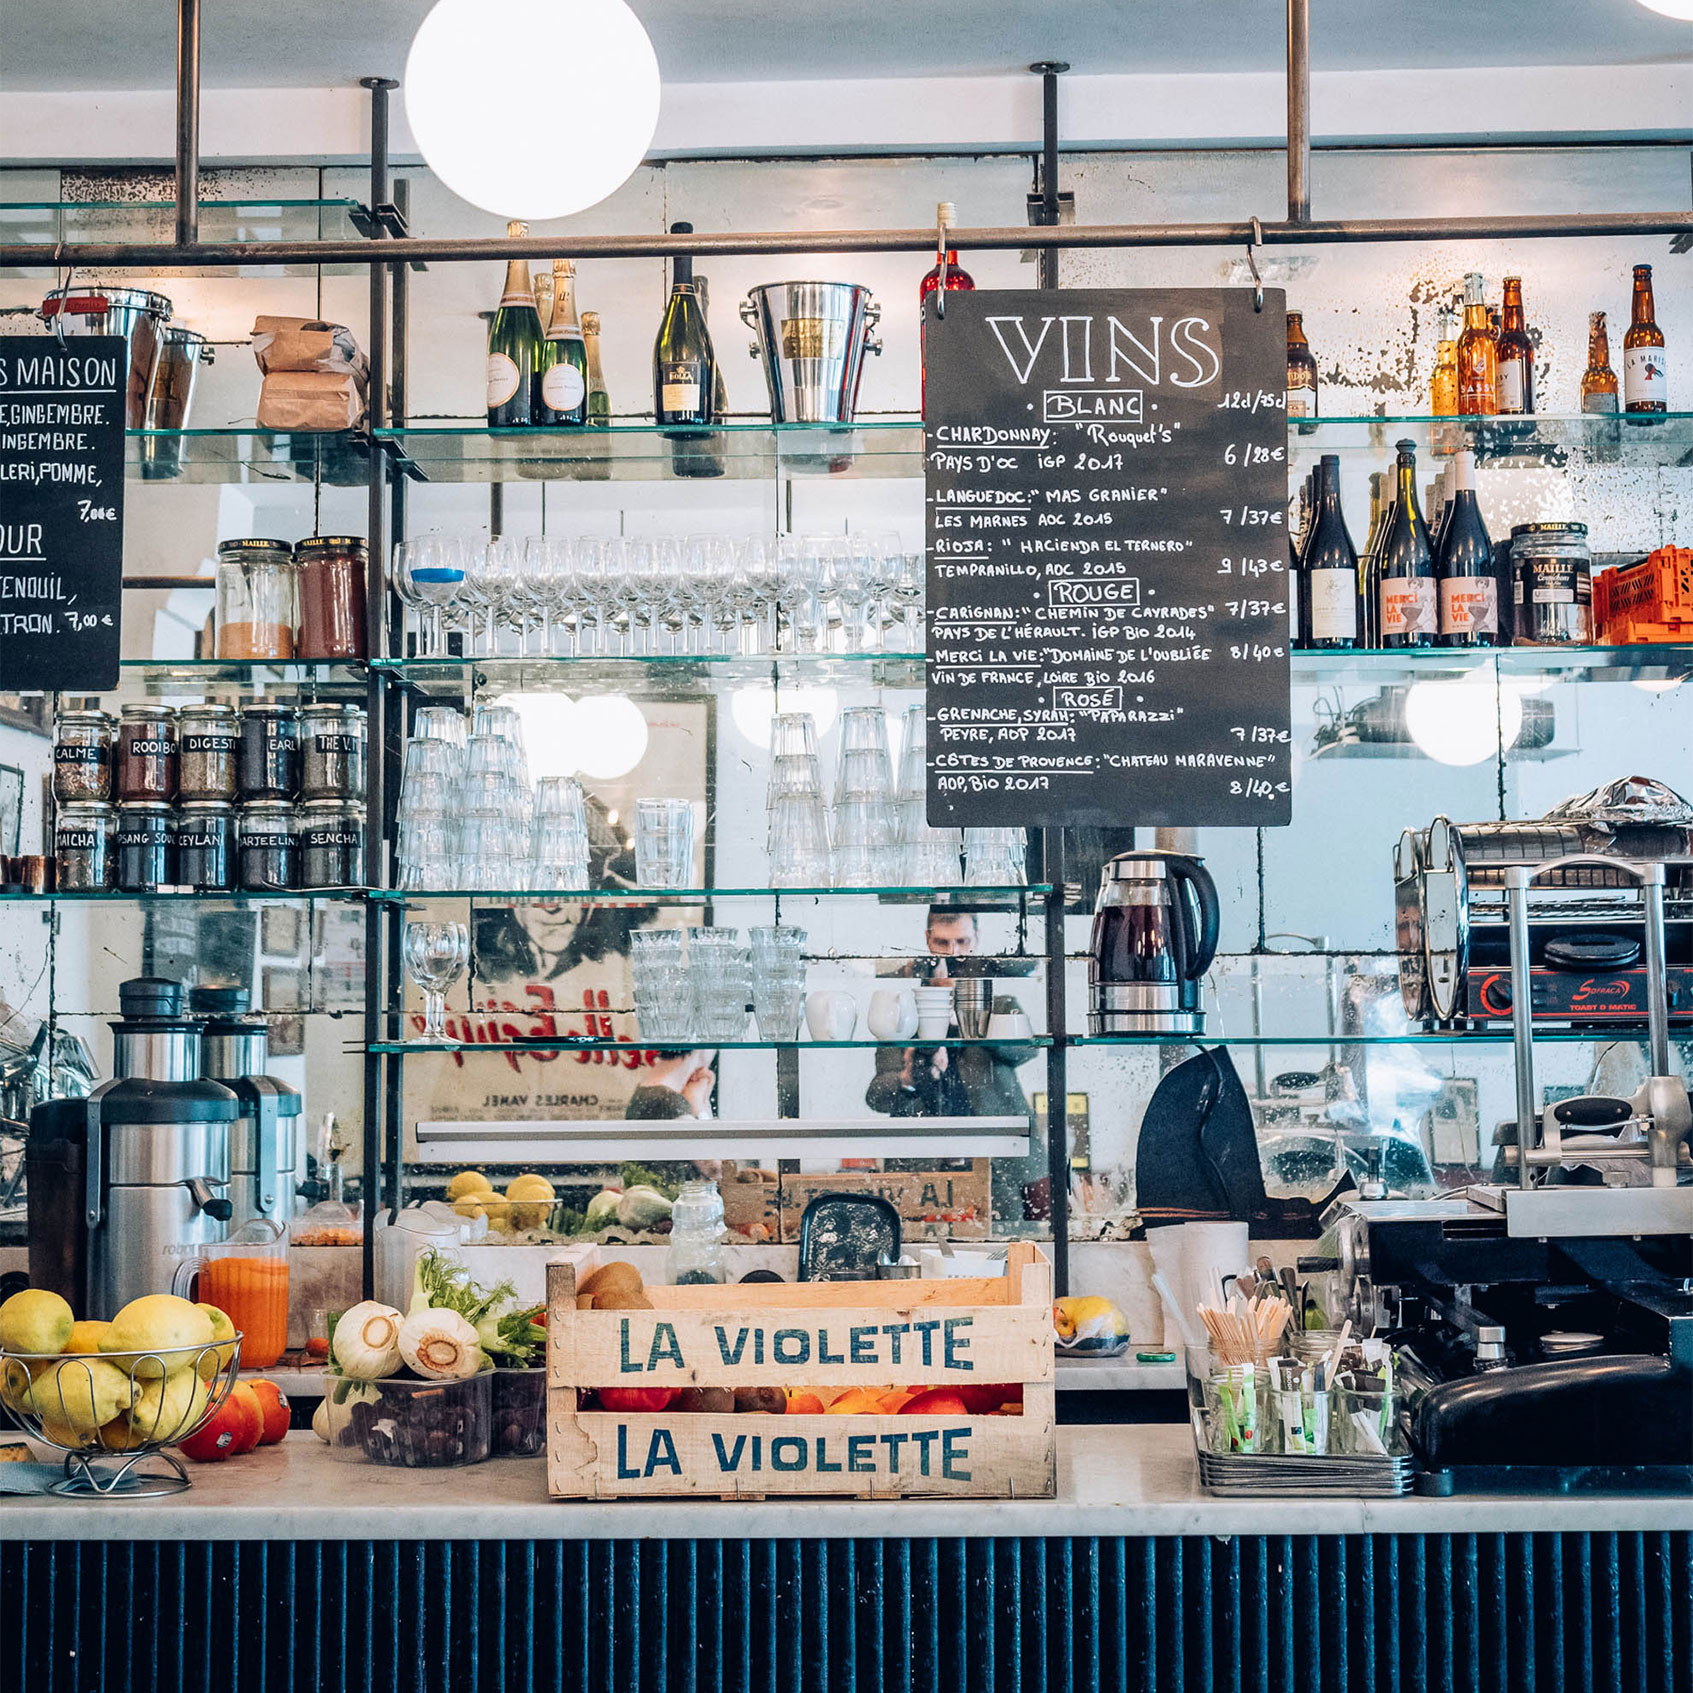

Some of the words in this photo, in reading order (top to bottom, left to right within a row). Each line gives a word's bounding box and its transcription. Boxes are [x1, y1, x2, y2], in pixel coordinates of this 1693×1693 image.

[984, 315, 1222, 389] VINS
[17, 356, 116, 387] MAISON
[1046, 394, 1141, 419] BLANC
[929, 451, 973, 474] PAYS
[1073, 452, 1124, 471] 2017
[1045, 489, 1082, 504] MAS
[934, 512, 963, 529] LES
[969, 514, 1028, 529] MARNES
[1038, 513, 1066, 527] AOC
[1072, 512, 1113, 526] 2015
[1045, 562, 1075, 577] AOC
[1082, 561, 1127, 576] 2015
[1533, 564, 1574, 573] MAILLE
[1051, 580, 1137, 605] ROUGE
[1103, 607, 1127, 622] DE
[1386, 604, 1397, 614] LA
[1452, 604, 1464, 612] LA
[1387, 614, 1402, 624] VIE
[1452, 613, 1469, 622] VIE
[930, 626, 971, 640] PAYS
[973, 626, 998, 642] DE
[1153, 623, 1197, 641] 2014
[989, 650, 1008, 663] LA
[1115, 649, 1136, 664] DE
[957, 672, 977, 687] DE
[1116, 669, 1156, 685] 2016
[1060, 689, 1115, 708] ROSÉ
[997, 727, 1030, 742] AOP
[1036, 726, 1077, 743] 2017
[56, 748, 97, 759] CALME
[992, 756, 1015, 770] DE
[1004, 775, 1049, 791] 2017
[179, 834, 221, 846] CEYLAN
[310, 832, 358, 845] SENCHA
[620, 1318, 685, 1374] LA
[714, 1316, 975, 1371] VIOLETTE
[617, 1424, 683, 1480] LA
[711, 1427, 973, 1482] VIOLETTE
